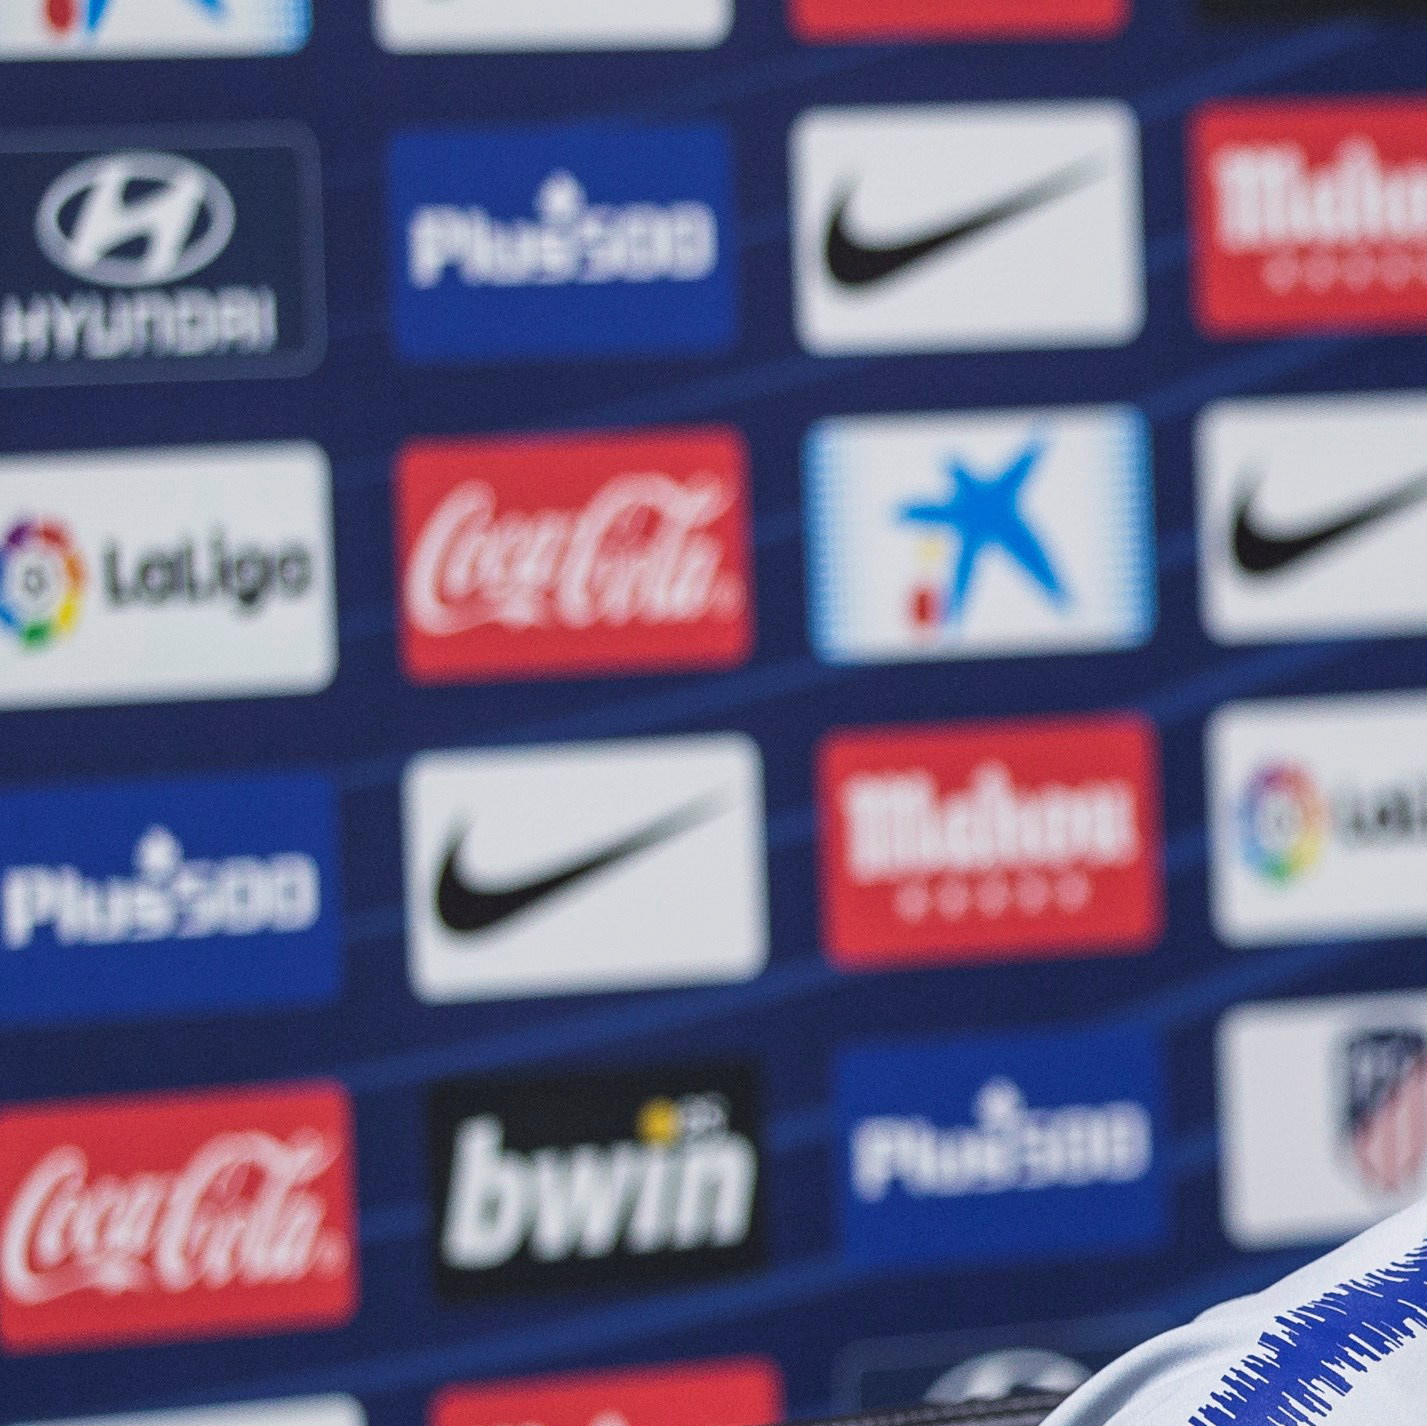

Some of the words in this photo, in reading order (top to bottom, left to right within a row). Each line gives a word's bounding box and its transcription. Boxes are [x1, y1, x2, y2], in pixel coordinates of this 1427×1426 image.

[408, 202, 718, 288] Plus500
[3, 854, 321, 950] Plus500
[442, 1098, 757, 1270] bwin
